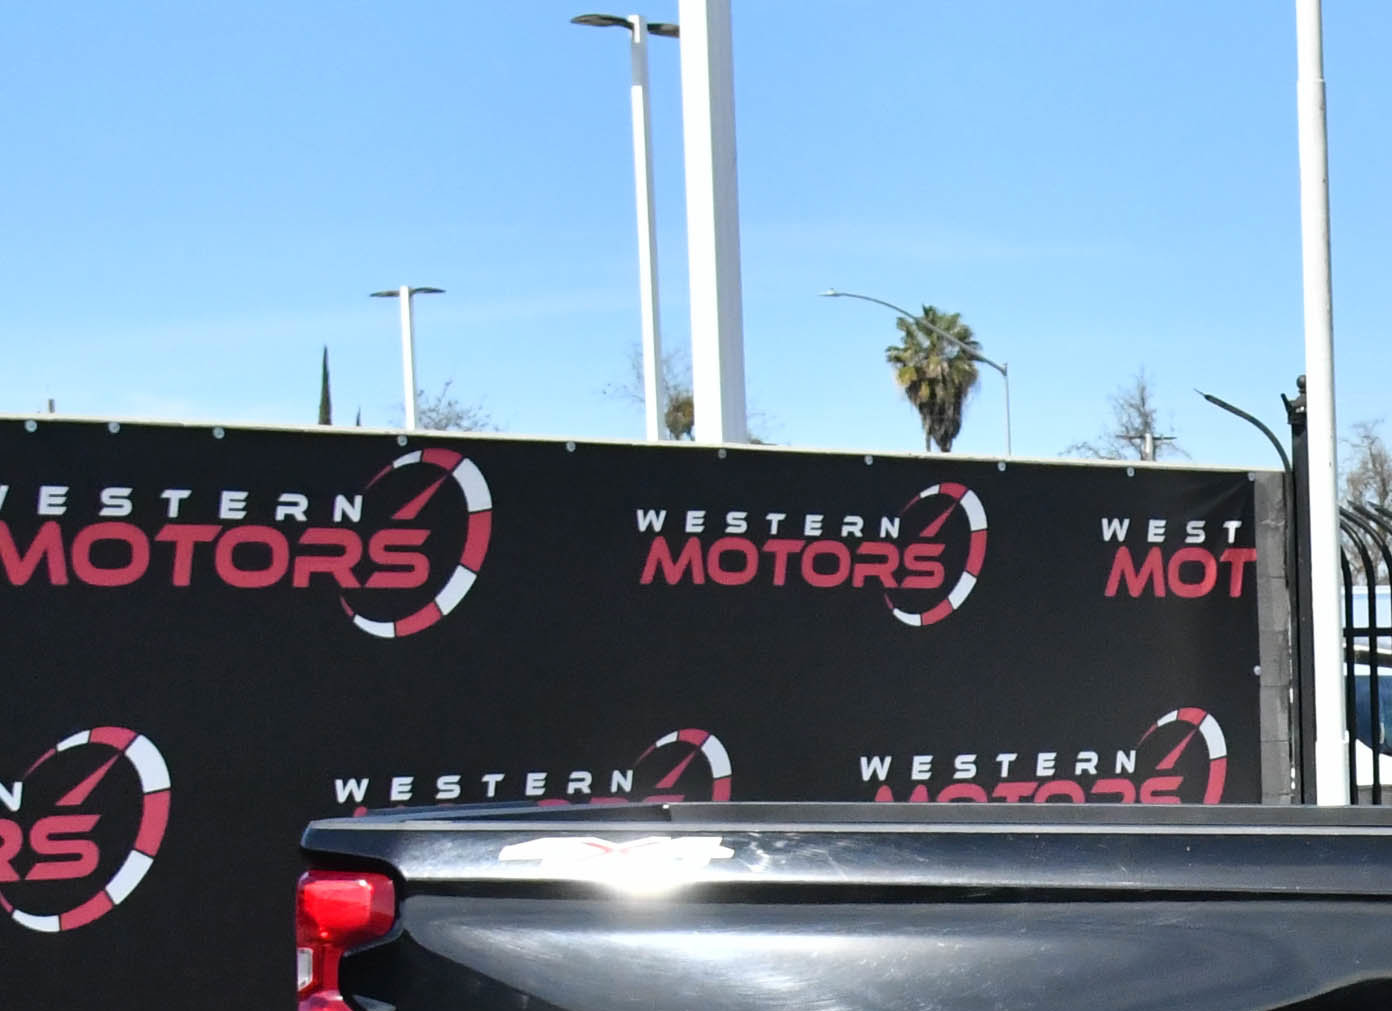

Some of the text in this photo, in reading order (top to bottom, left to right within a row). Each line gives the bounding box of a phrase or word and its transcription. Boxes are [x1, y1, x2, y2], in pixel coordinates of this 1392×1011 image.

[0, 484, 363, 522] ESTERN
[636, 508, 900, 539] WESTERN
[1101, 517, 1242, 544] WEST
[0, 520, 431, 589] MOTORS
[640, 535, 945, 590] MOTORS
[1104, 545, 1257, 599] MOT
[859, 750, 1137, 781] WESTERN
[335, 769, 633, 803] WESTERN
